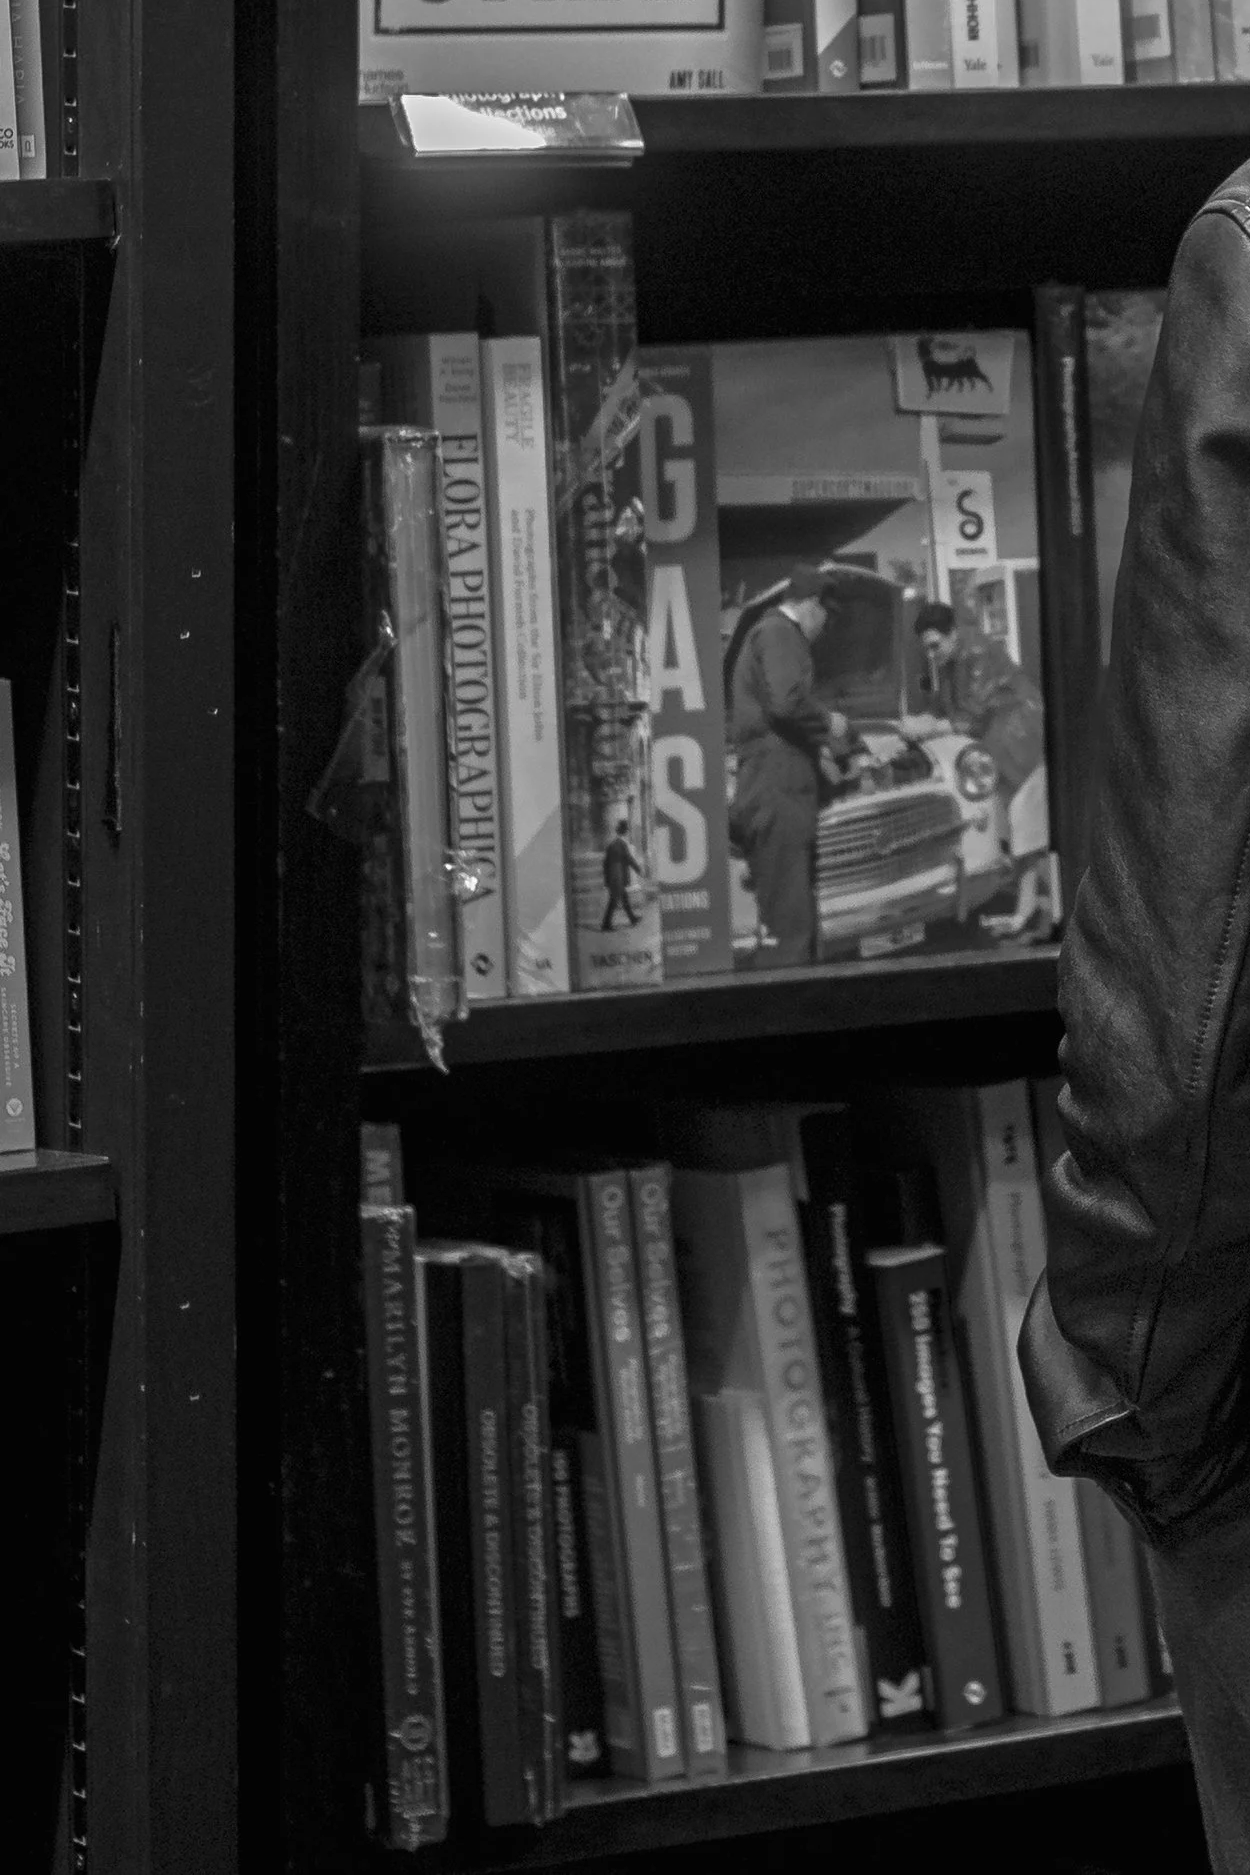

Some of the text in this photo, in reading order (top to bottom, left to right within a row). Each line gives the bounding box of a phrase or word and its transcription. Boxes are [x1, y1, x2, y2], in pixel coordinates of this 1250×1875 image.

[963, 57, 987, 71] Yale
[442, 431, 486, 556] FLORA
[601, 1184, 625, 1239] Our
[640, 1182, 673, 1338] Our Selves
[607, 1244, 632, 1343] Selves
[382, 1250, 417, 1547] MARILYN MONROE
[766, 1229, 839, 1594] PHOTOGRAPHY
